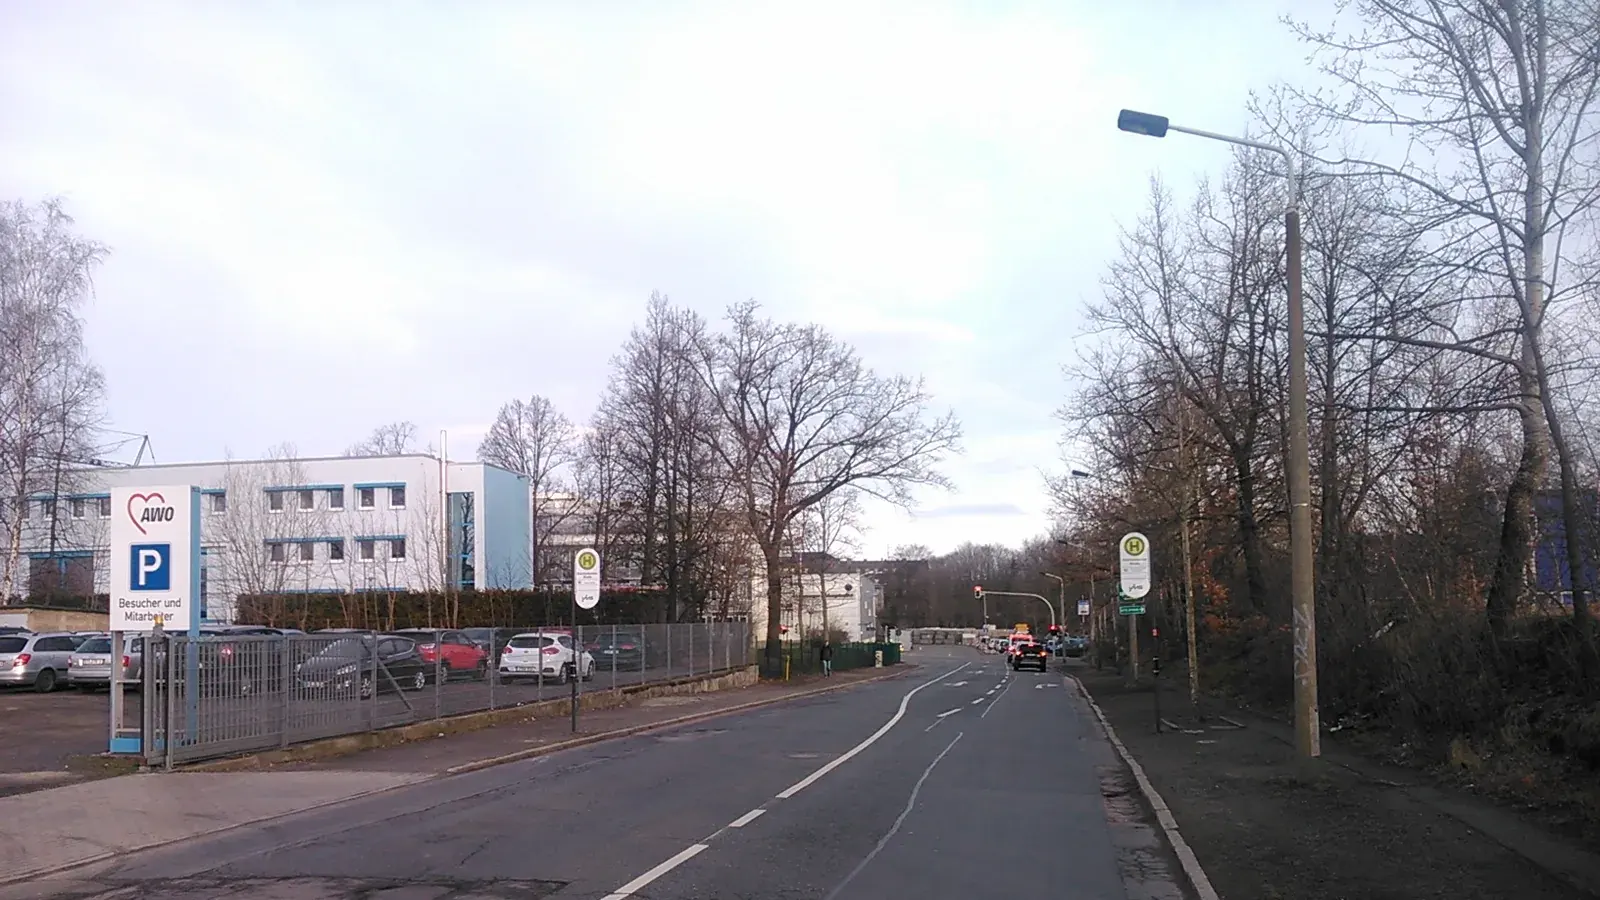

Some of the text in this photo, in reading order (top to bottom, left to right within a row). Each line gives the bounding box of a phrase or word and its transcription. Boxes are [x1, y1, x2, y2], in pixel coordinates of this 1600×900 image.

[141, 507, 174, 522] AWO
[1130, 541, 1139, 551] H
[583, 556, 592, 566] H
[139, 549, 162, 586] P
[119, 598, 181, 608] Besucher und
